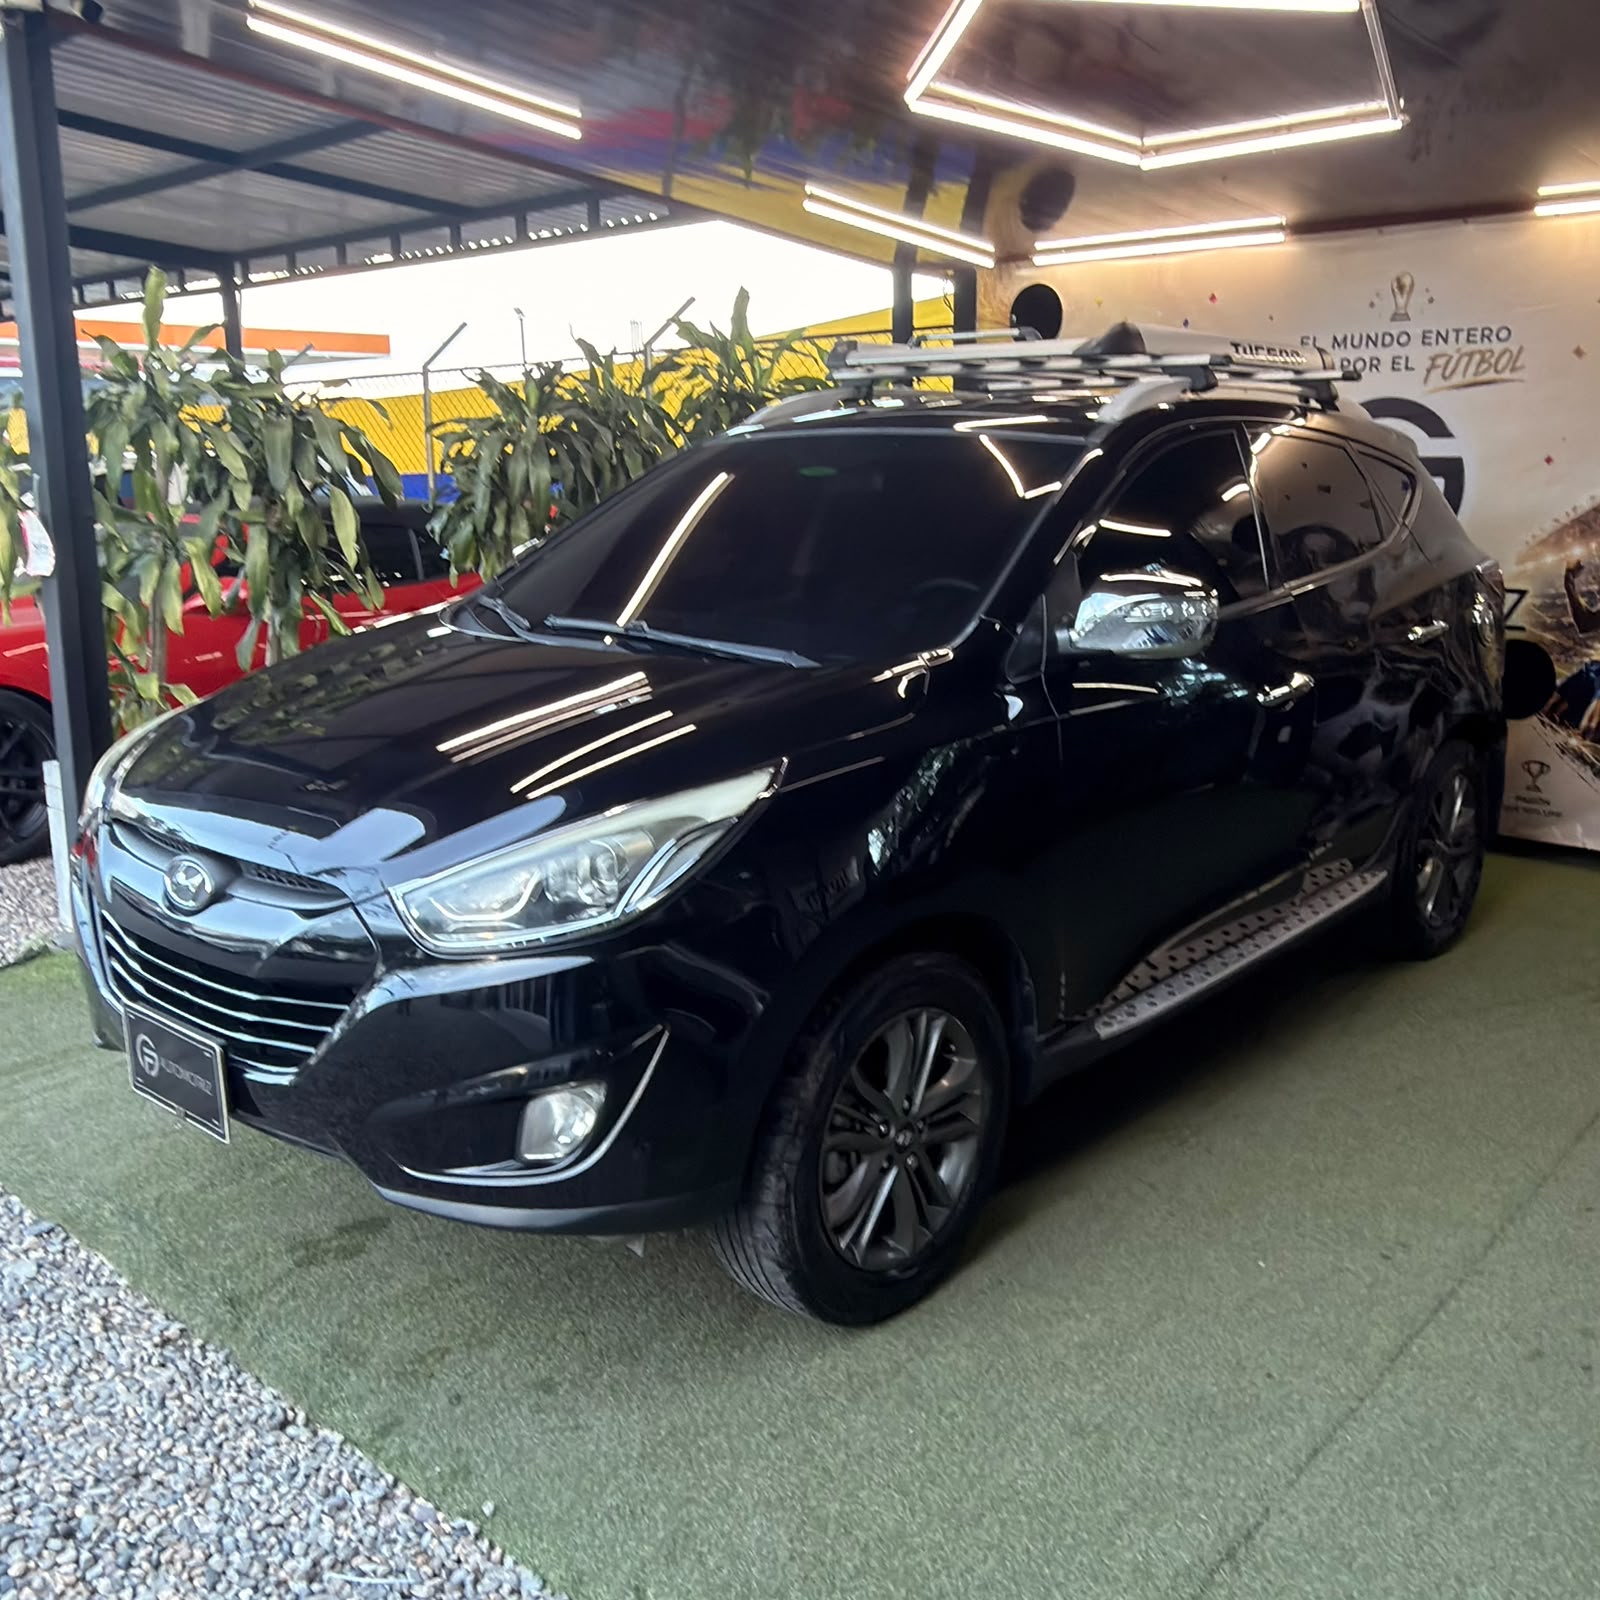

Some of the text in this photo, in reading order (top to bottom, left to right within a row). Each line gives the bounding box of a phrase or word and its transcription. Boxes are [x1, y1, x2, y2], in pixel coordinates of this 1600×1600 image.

[1332, 331, 1411, 350] MUNDO
[1421, 326, 1512, 346] ENTERO
[1340, 356, 1381, 373] POR
[1391, 355, 1415, 372] EL
